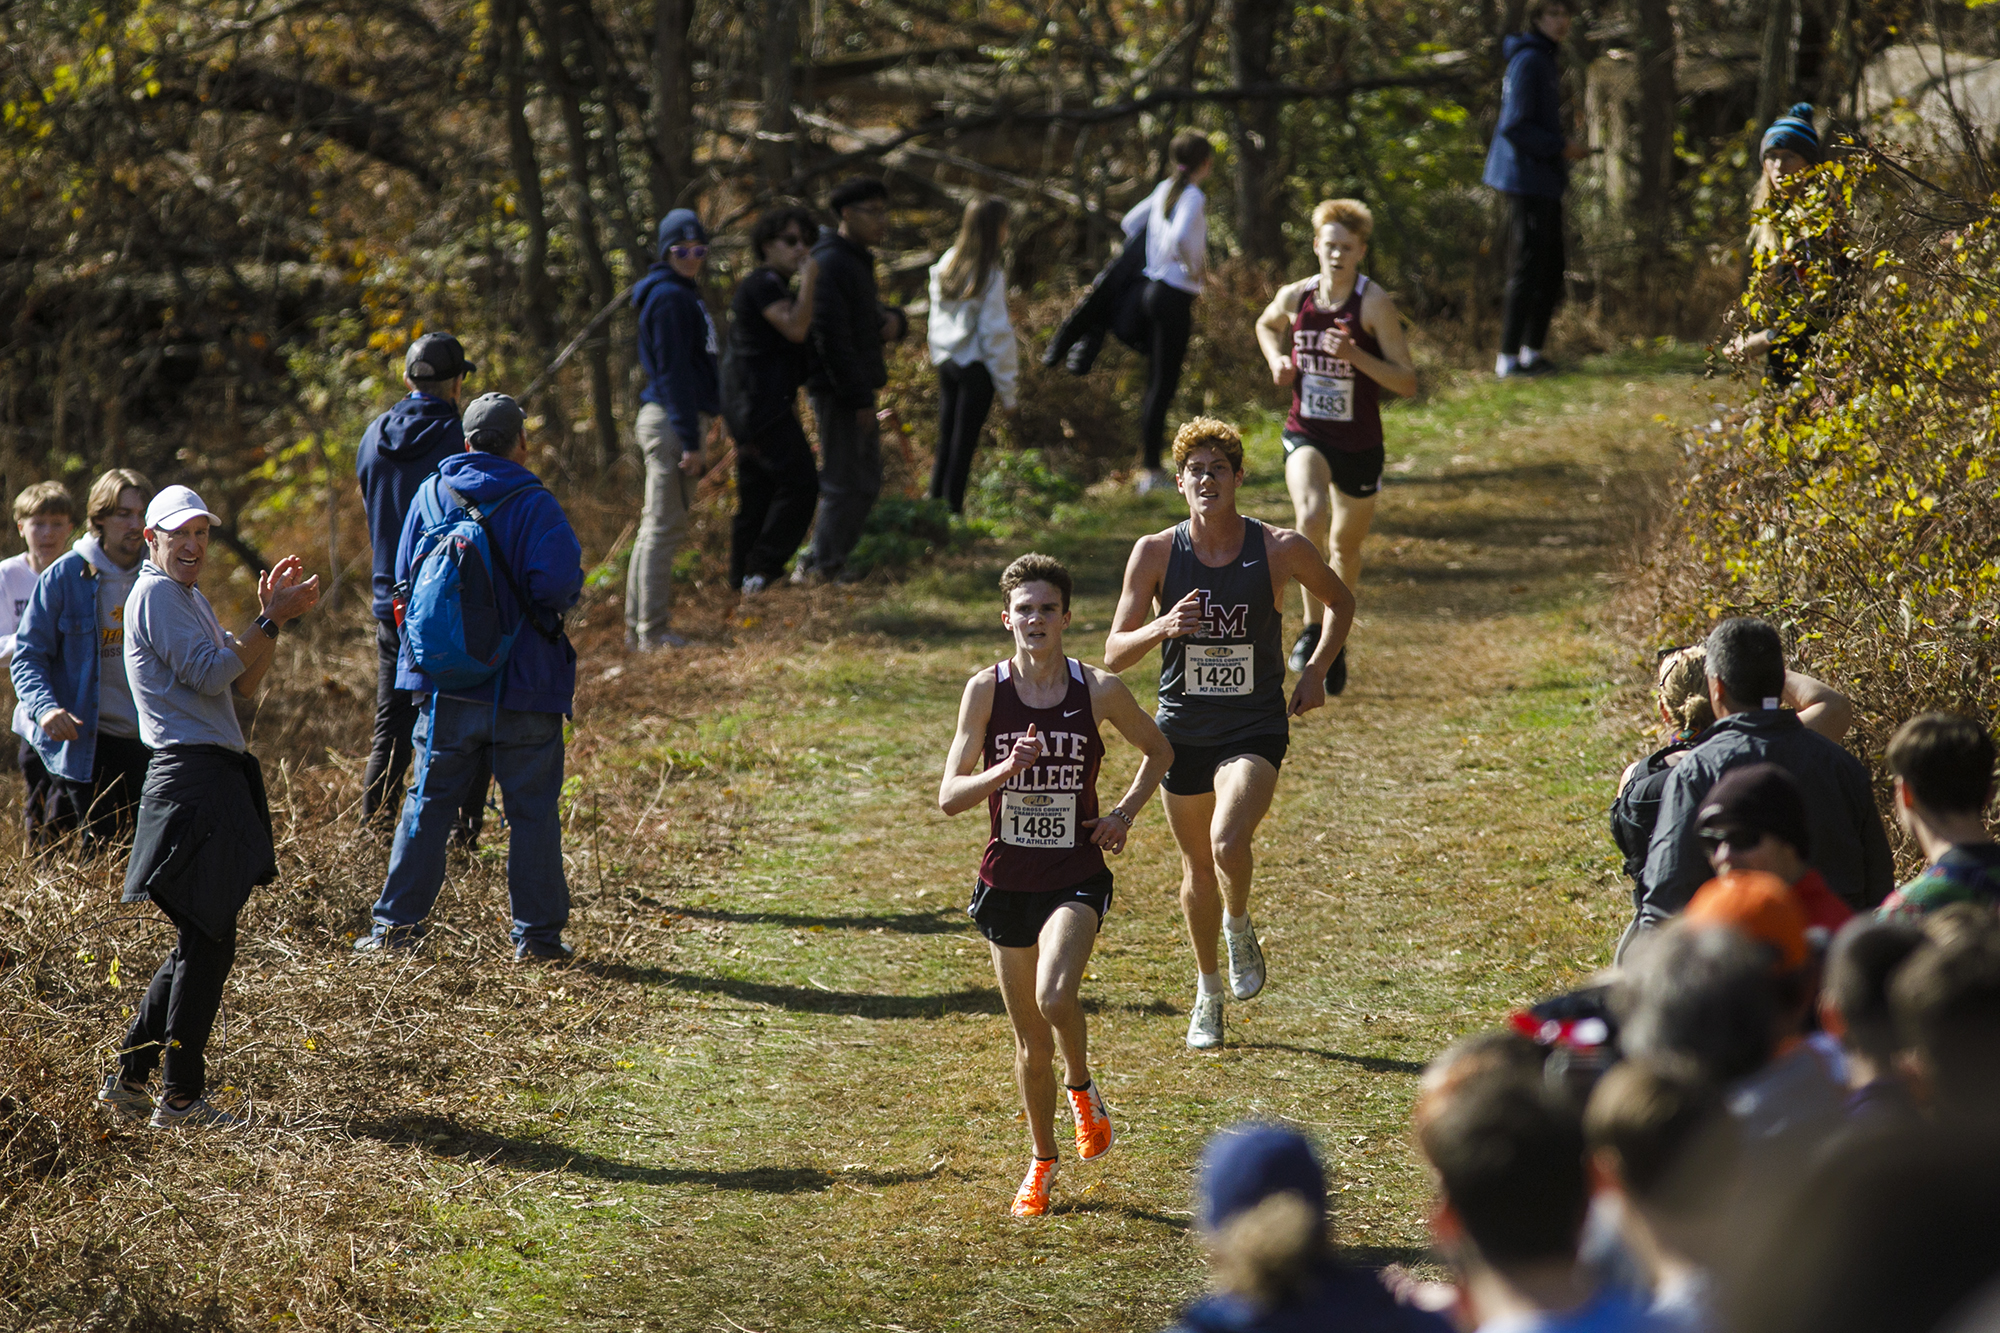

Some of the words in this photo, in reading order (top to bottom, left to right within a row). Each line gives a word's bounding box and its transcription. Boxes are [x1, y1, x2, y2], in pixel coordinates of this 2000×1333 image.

[1307, 394, 1346, 414] 1483
[1195, 590, 1248, 638] LM
[1193, 666, 1246, 686] 1420
[1000, 765, 1083, 791] OLLEGE
[1010, 815, 1065, 838] 1485
